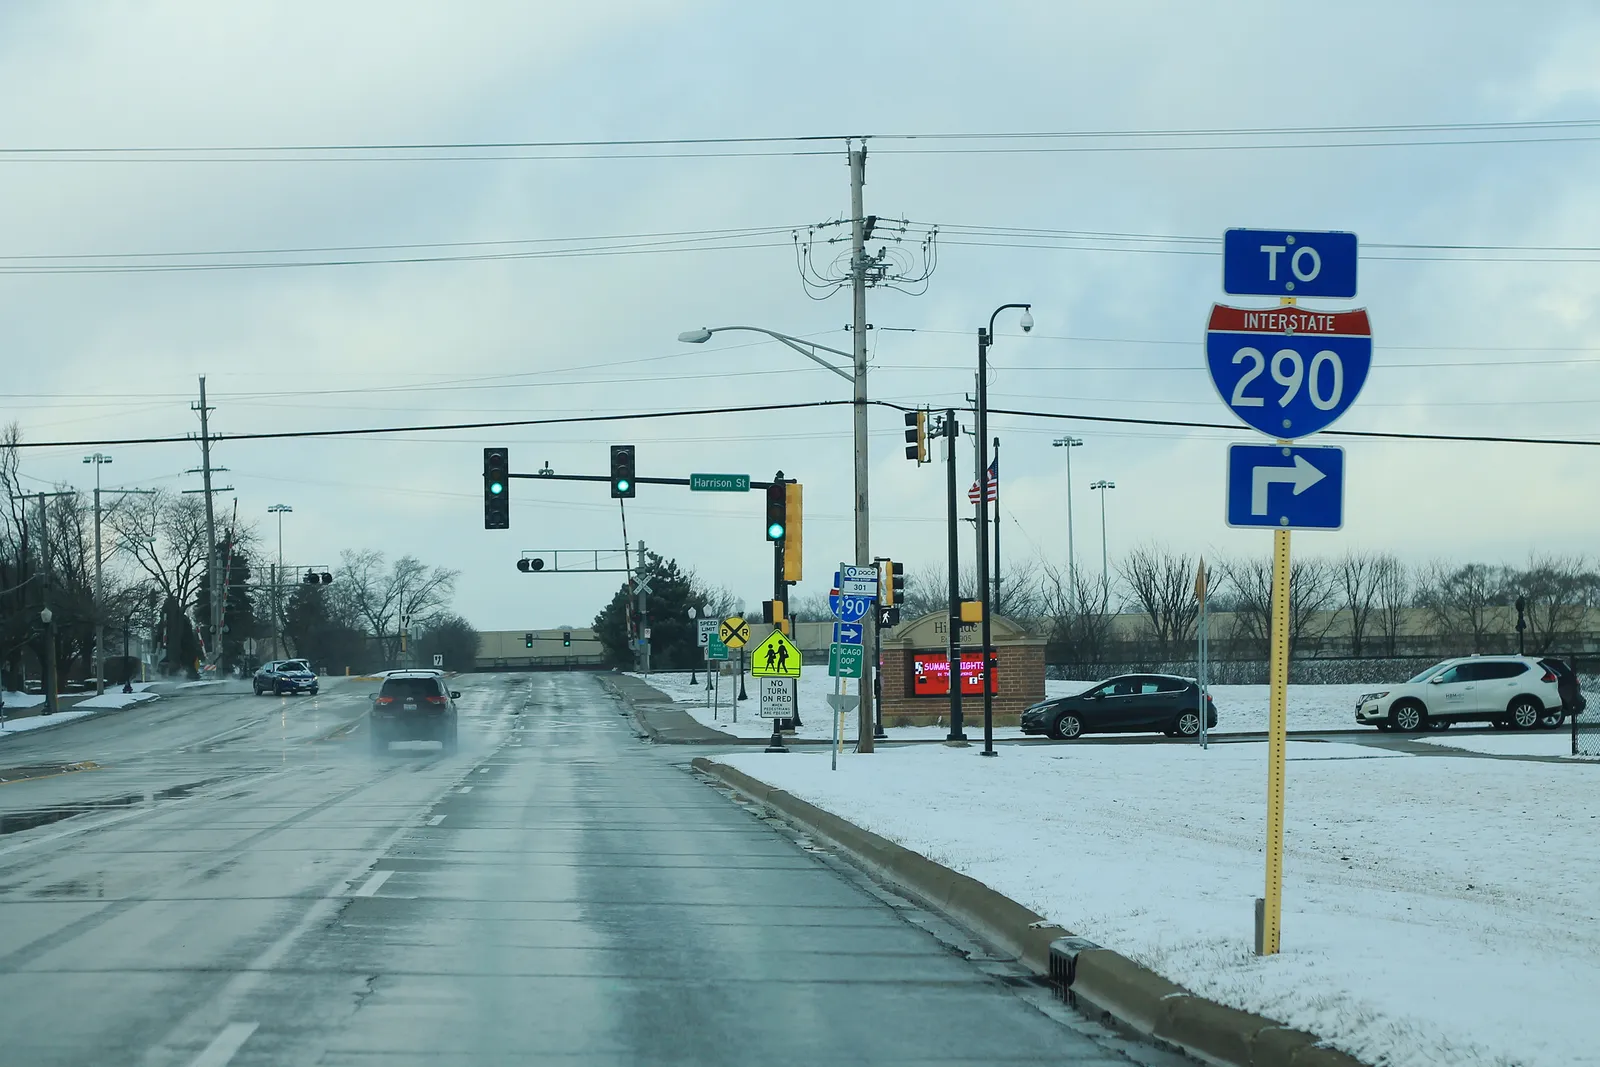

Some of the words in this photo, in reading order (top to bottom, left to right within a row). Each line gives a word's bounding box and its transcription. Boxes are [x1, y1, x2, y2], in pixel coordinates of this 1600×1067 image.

[1260, 245, 1322, 282] TO
[1244, 313, 1335, 331] INTERSTATE
[1231, 347, 1344, 411] 290
[694, 477, 732, 488] Harrison
[735, 478, 746, 488] St
[835, 599, 865, 616] 290
[701, 633, 708, 642] 3
[742, 629, 749, 637] R
[831, 647, 862, 656] CICAGO
[839, 657, 855, 665] OOP
[924, 662, 951, 671] SUMME
